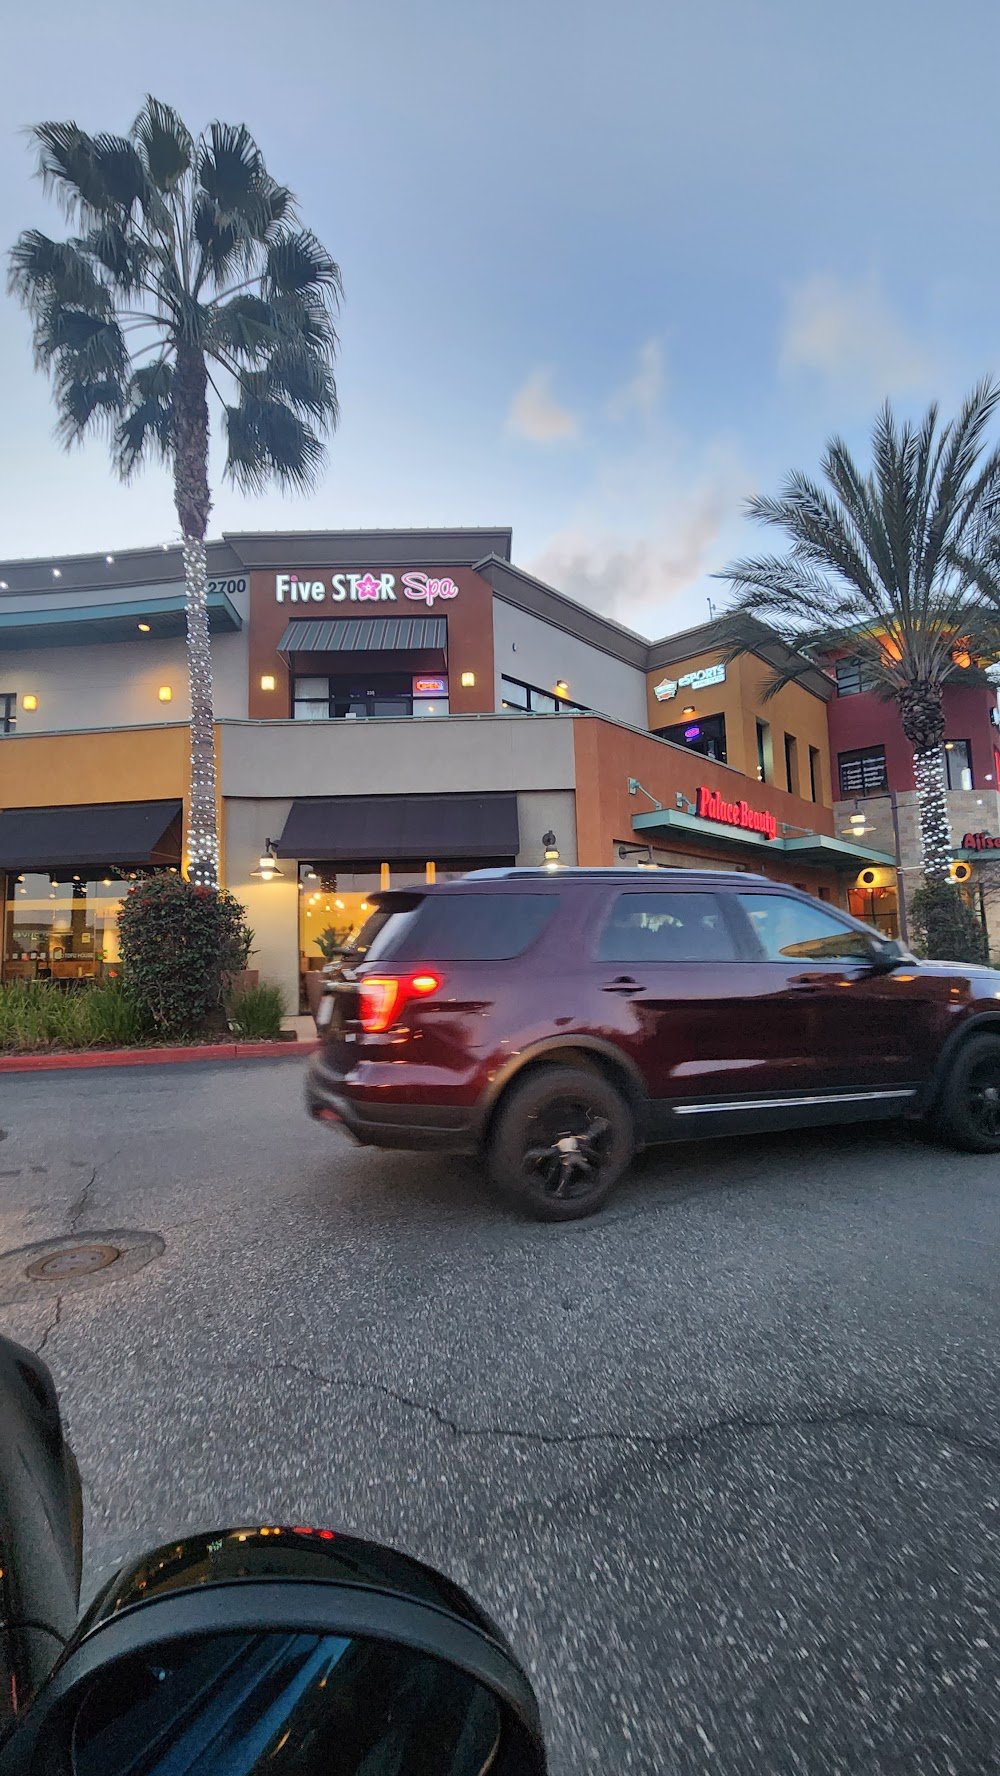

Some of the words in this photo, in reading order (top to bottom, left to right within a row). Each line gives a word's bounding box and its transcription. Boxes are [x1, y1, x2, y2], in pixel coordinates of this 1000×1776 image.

[208, 579, 246, 594] 2700
[276, 574, 325, 601] Five
[401, 572, 459, 606] Spa
[700, 785, 740, 826] Palace
[740, 801, 777, 841] Beauty
